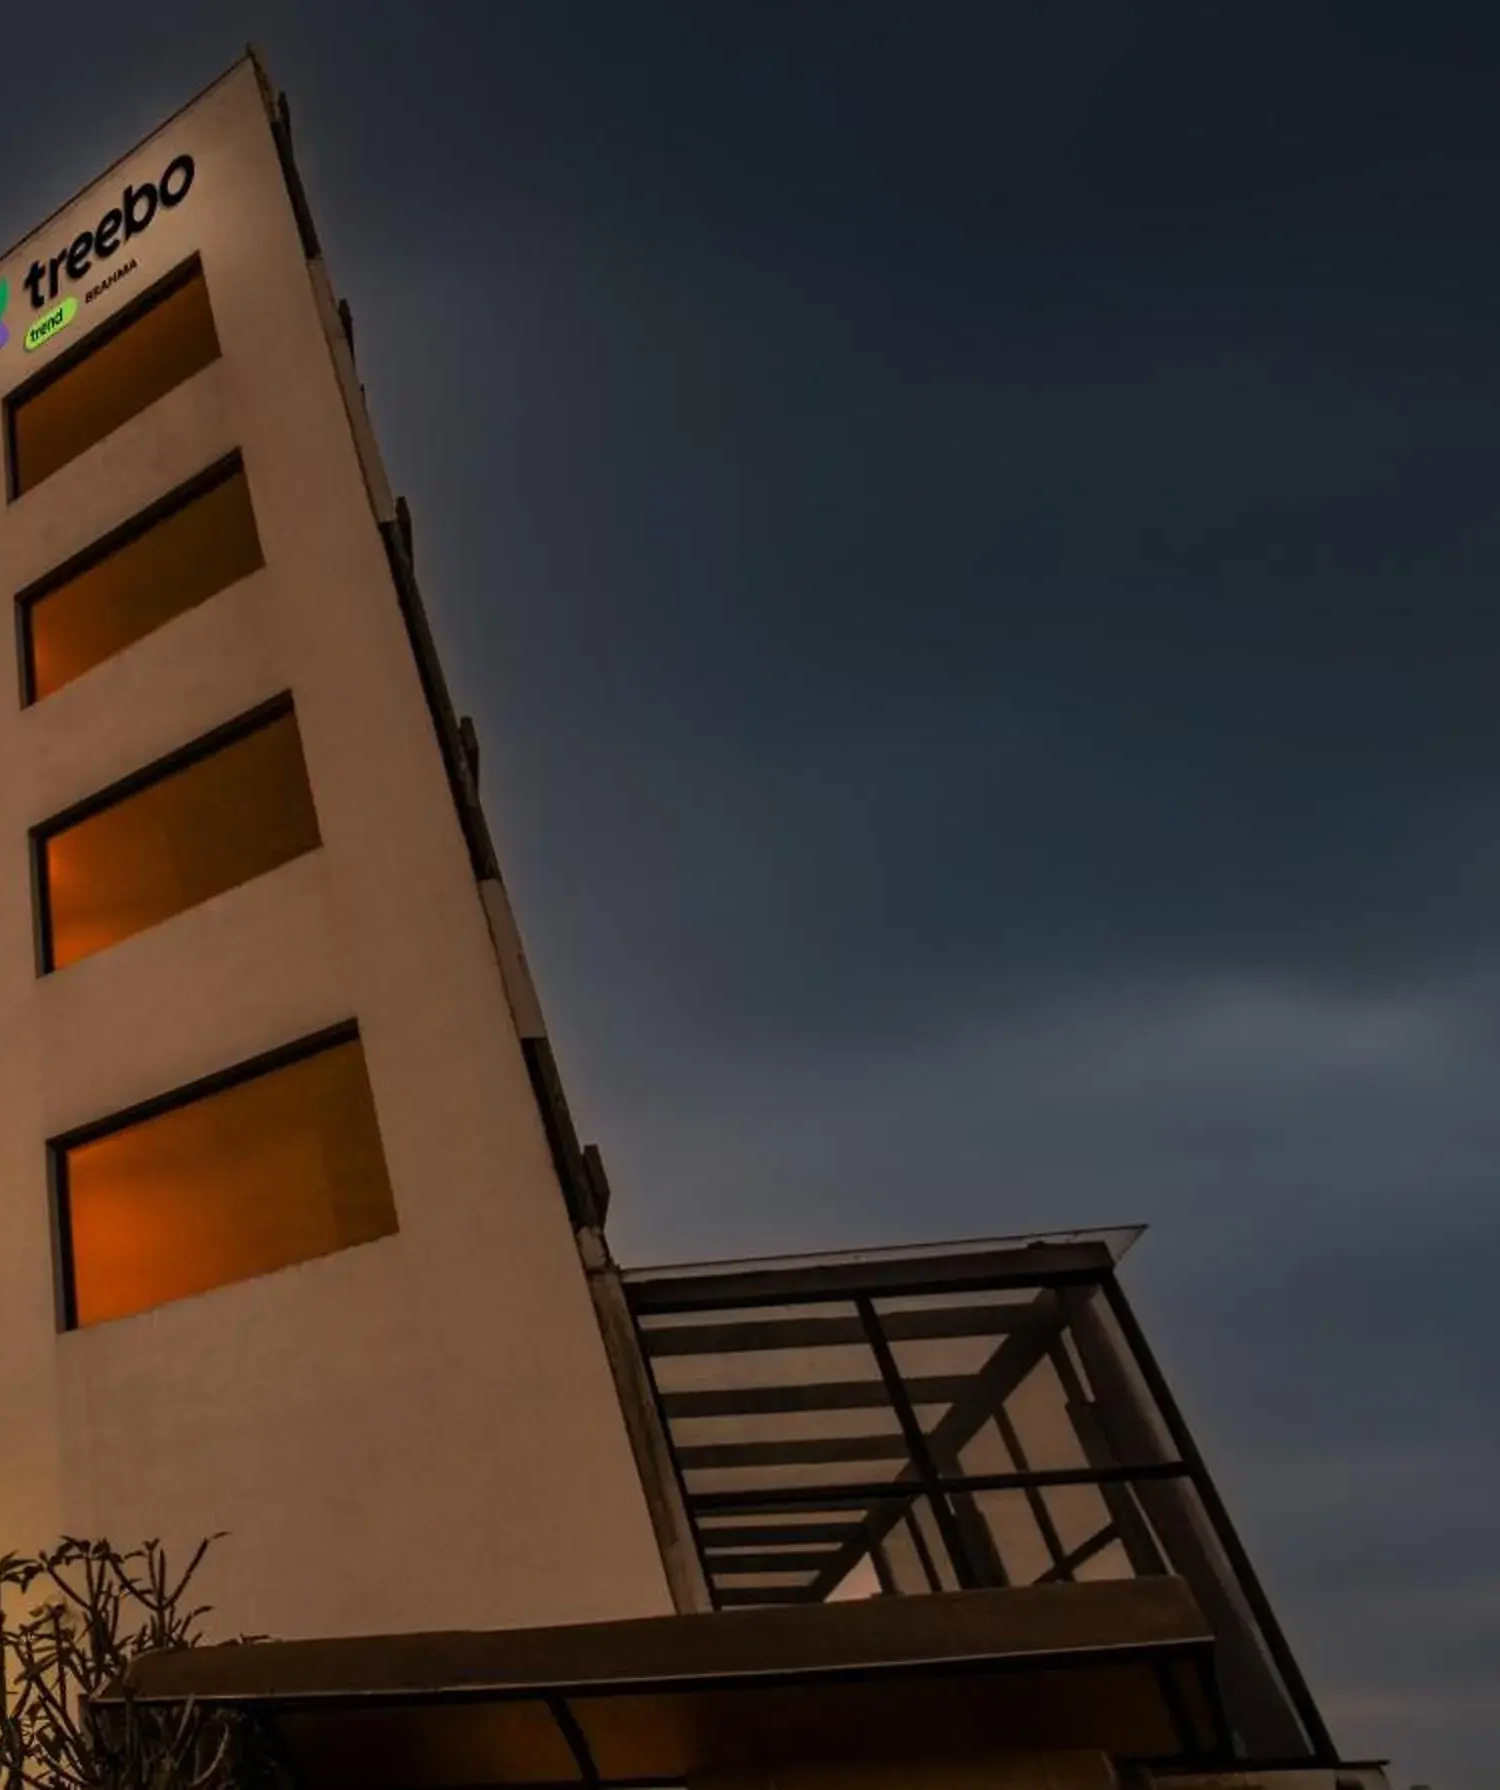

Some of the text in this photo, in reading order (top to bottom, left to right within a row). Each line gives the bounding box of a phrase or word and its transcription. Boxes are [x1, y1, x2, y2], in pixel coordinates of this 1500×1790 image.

[23, 154, 195, 309] treebo
[85, 258, 138, 304] BRAHMA
[29, 308, 64, 341] trend
